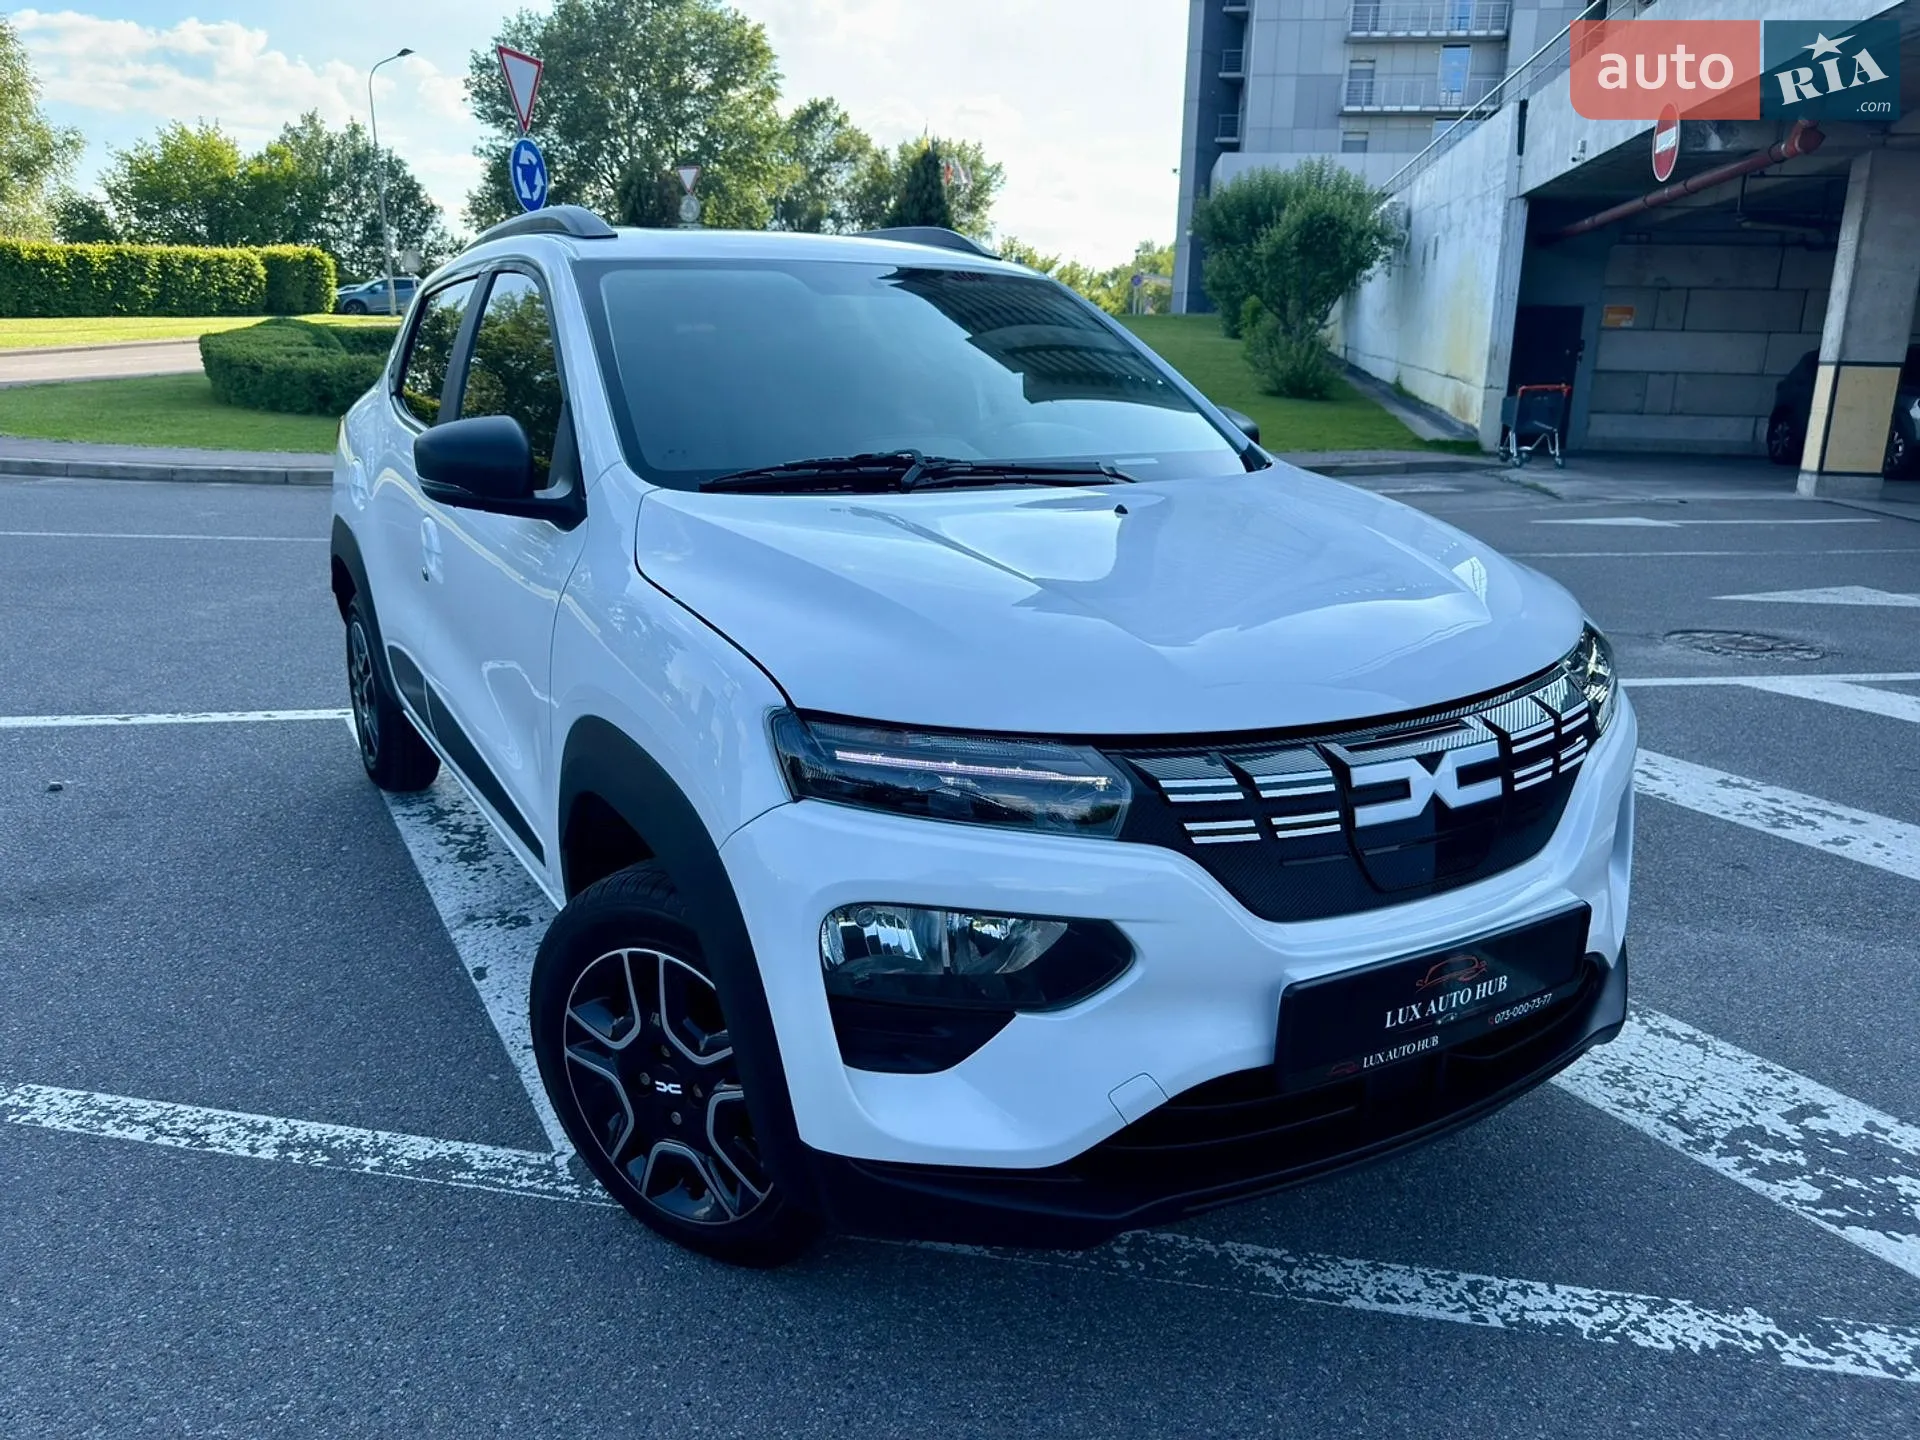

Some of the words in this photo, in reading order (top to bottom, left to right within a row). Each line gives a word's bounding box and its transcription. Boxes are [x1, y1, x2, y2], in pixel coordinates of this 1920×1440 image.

[1384, 1002, 1422, 1029] LUX
[1425, 987, 1472, 1017] AUTO
[1475, 974, 1508, 1000] HUB
[1363, 1051, 1385, 1069] LUX
[1385, 1042, 1416, 1062] AUTO
[1417, 1035, 1439, 1052] HUB
